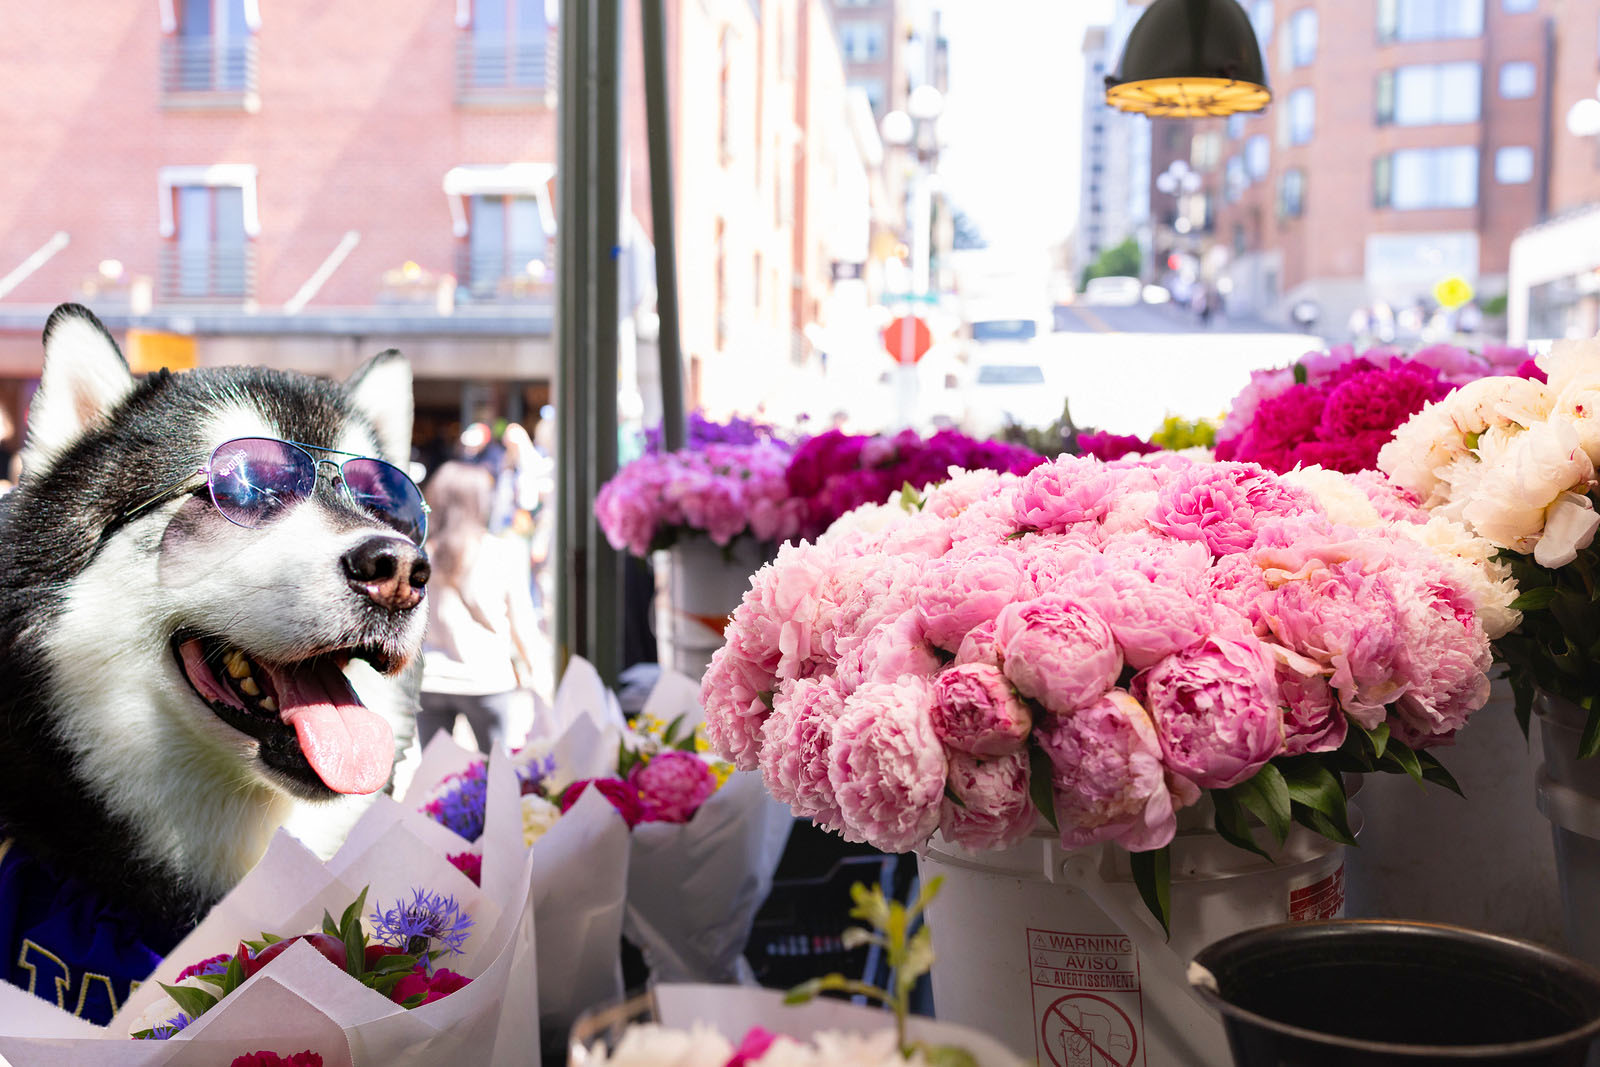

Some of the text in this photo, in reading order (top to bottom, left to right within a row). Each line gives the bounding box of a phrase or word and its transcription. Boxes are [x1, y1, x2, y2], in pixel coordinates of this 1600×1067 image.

[227, 449, 247, 471] DUBS
[1049, 935, 1132, 953] WARNING
[1065, 955, 1118, 971] AVISO
[1054, 971, 1134, 988] AVERTISSEMENT
